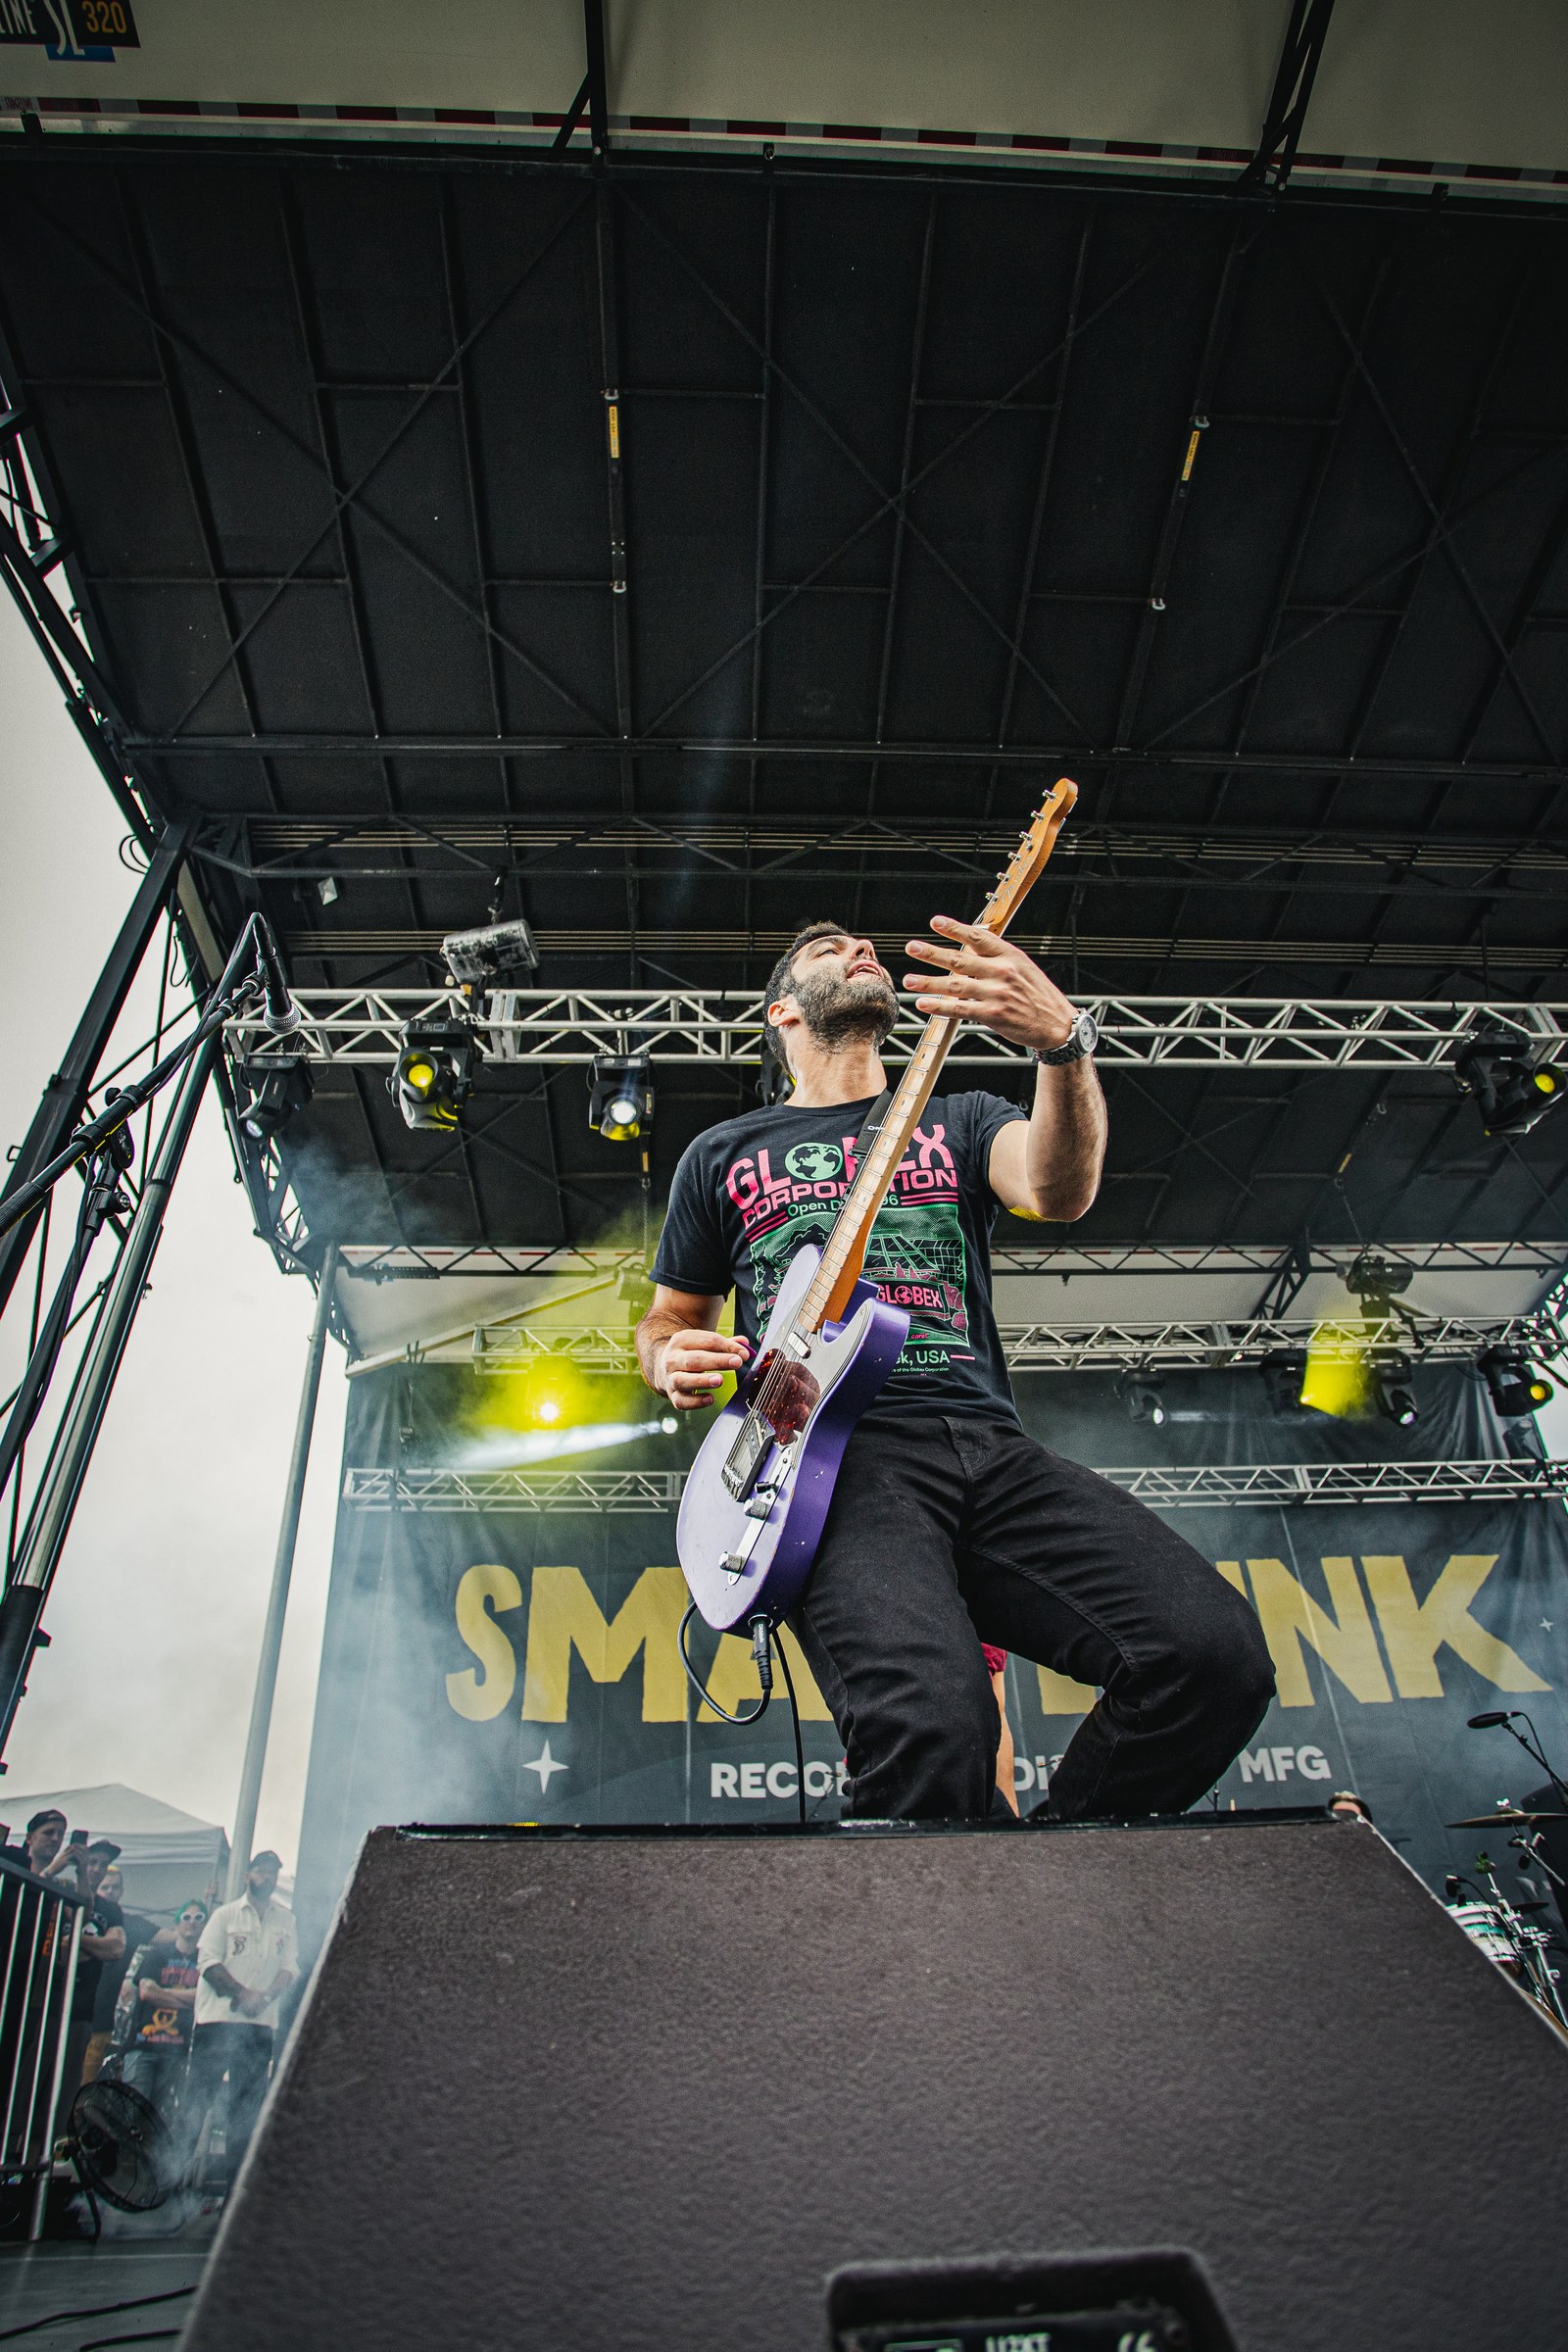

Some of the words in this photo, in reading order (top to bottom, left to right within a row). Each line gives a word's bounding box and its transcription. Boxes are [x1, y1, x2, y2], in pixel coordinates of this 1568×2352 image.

[81, 1, 127, 33] 320
[787, 1201, 827, 1217] Open
[916, 1349, 951, 1364] USA
[1237, 1745, 1333, 1783] MFG
